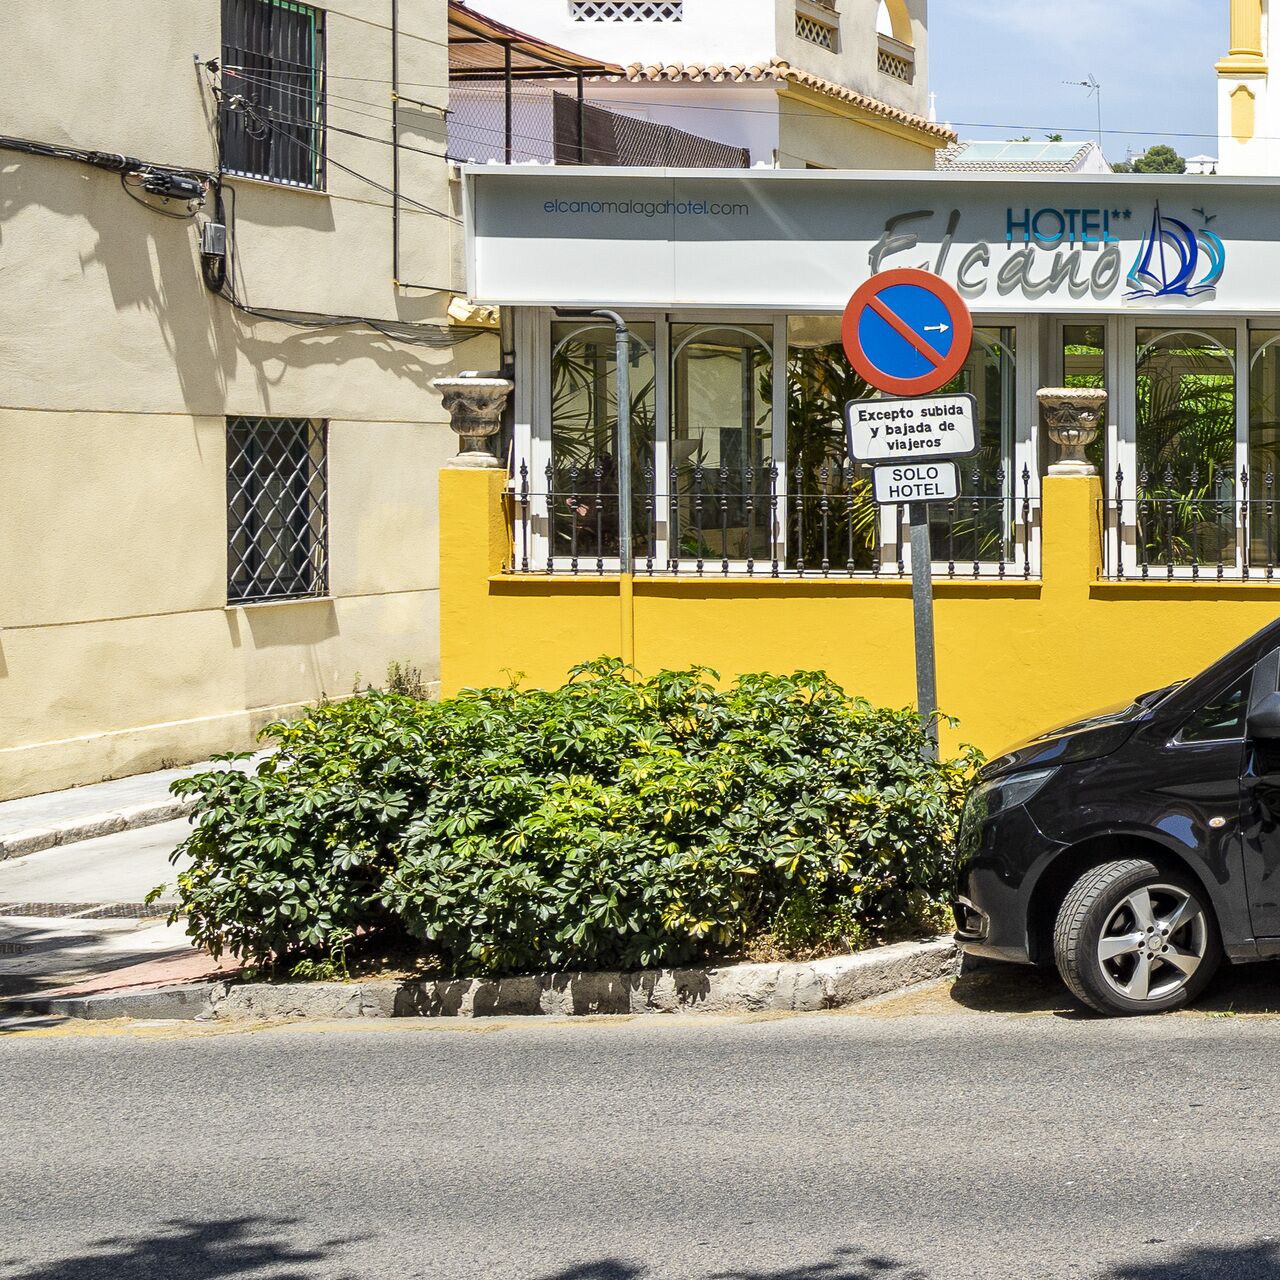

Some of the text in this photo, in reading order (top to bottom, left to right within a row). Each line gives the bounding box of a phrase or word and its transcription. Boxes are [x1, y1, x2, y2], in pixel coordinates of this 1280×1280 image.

[543, 199, 749, 218] elcanomalagahotel.com
[869, 209, 1122, 297] Elcano
[858, 404, 964, 422] Excepto subida
[870, 420, 955, 438] y bajada de
[887, 438, 941, 451] viajeros
[892, 467, 938, 481] SOLO
[889, 483, 945, 498] HOTEL
